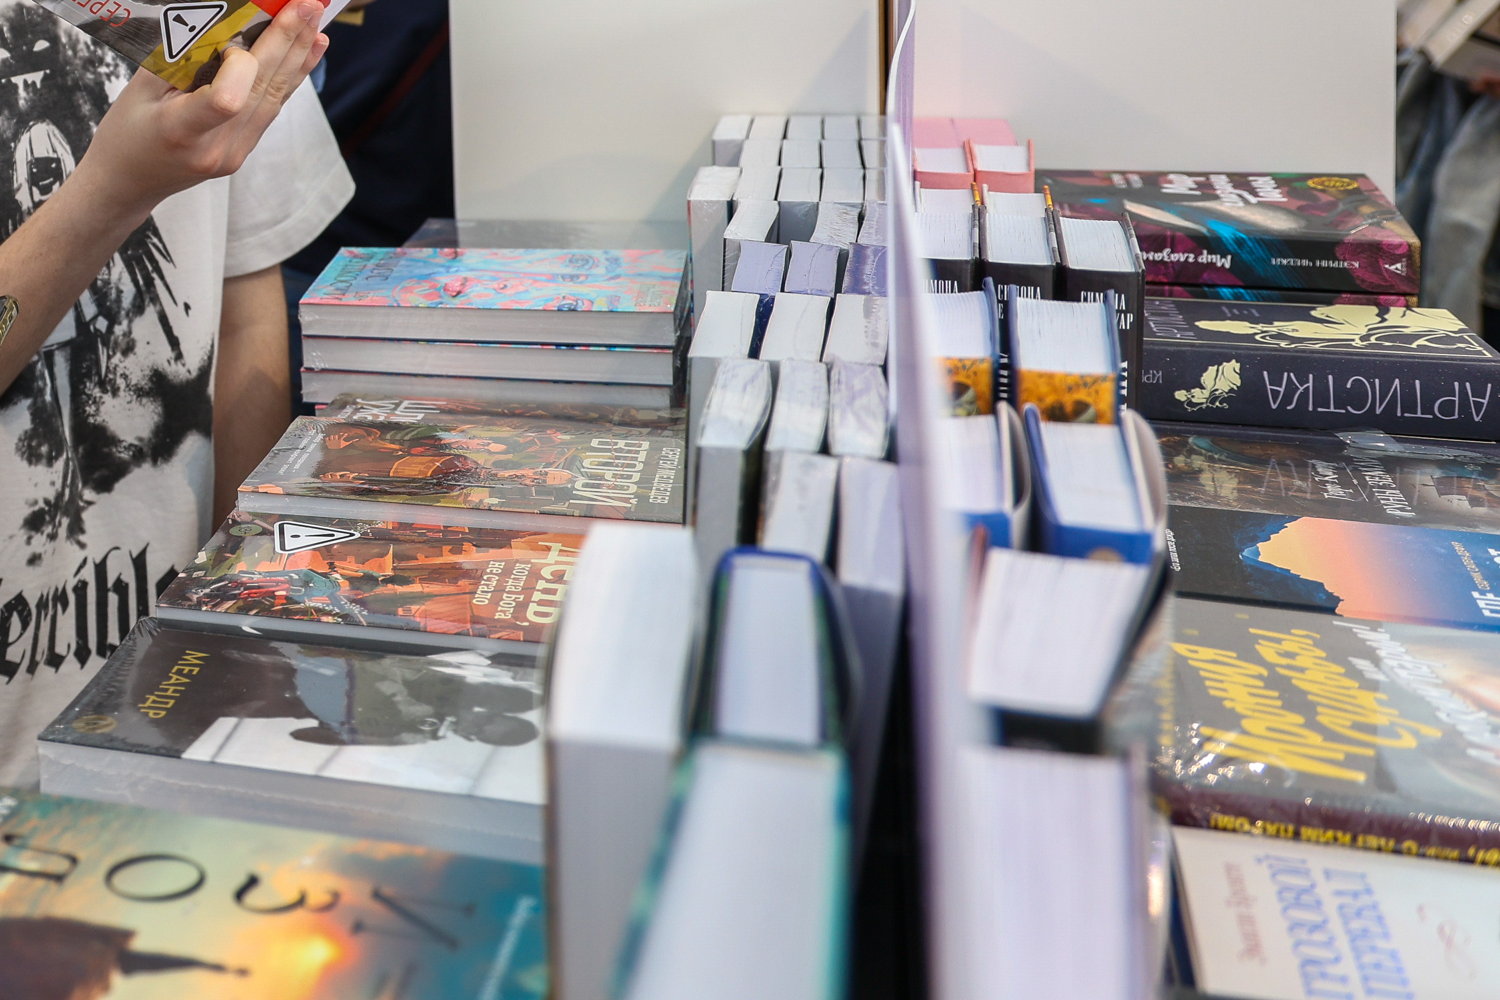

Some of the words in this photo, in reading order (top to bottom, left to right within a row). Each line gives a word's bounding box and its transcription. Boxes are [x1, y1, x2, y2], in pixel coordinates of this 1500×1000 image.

[1197, 249, 1232, 269] Мир
[998, 283, 1042, 300] СИОНА
[1080, 290, 1127, 311] СИМНА
[1262, 369, 1493, 422] АРТИСТКА
[569, 438, 651, 508] ВТОРОЙ
[656, 446, 681, 474] СЕРГЕЙ
[649, 471, 677, 505] МЕДВЕДЕВ
[1372, 488, 1416, 517] РУНЫ
[486, 560, 505, 574] не
[504, 563, 531, 592] когда
[472, 574, 499, 606] стало
[494, 594, 525, 620] Бога
[138, 650, 210, 719] МЕАНДР
